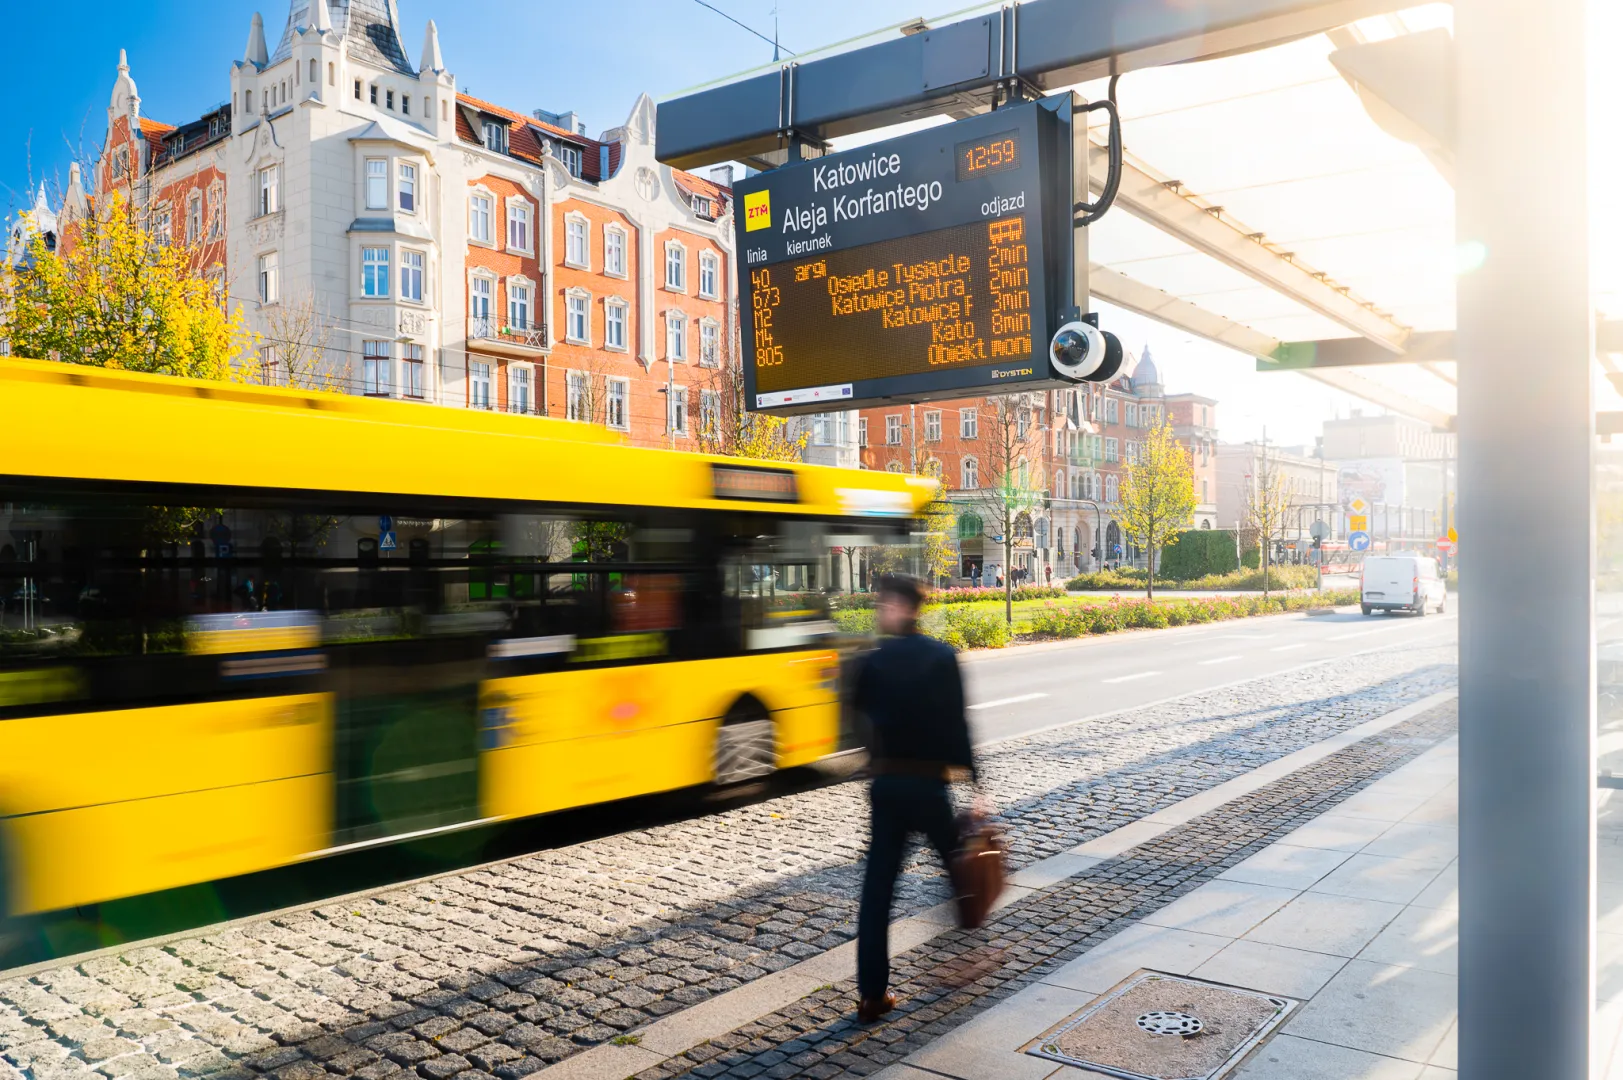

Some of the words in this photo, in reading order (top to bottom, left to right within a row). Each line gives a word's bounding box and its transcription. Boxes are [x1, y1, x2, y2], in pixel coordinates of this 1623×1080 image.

[965, 139, 1015, 171] 12:59
[813, 152, 901, 192] Katowice
[748, 204, 768, 219] ZTM
[782, 204, 828, 235] Aleja
[834, 180, 943, 224] Korfantego
[981, 191, 1025, 217] odjazd
[747, 247, 768, 264] linia
[786, 231, 832, 256] kierunek
[751, 268, 771, 289] 40
[753, 286, 780, 309] 673
[827, 268, 889, 296] Osiedle
[988, 244, 1028, 269] 2min
[754, 308, 772, 328] M2
[832, 288, 905, 316] Katowice
[909, 278, 965, 303] Piotra
[989, 267, 1029, 291] 2min
[756, 328, 773, 348] M4
[882, 301, 960, 329] Katowice
[990, 290, 1030, 313] 3min
[756, 345, 784, 367] 805
[932, 319, 975, 343] Kato
[991, 313, 1031, 335] 8min
[928, 338, 987, 365] Obiekt
[999, 368, 1033, 378] DYSTEN
